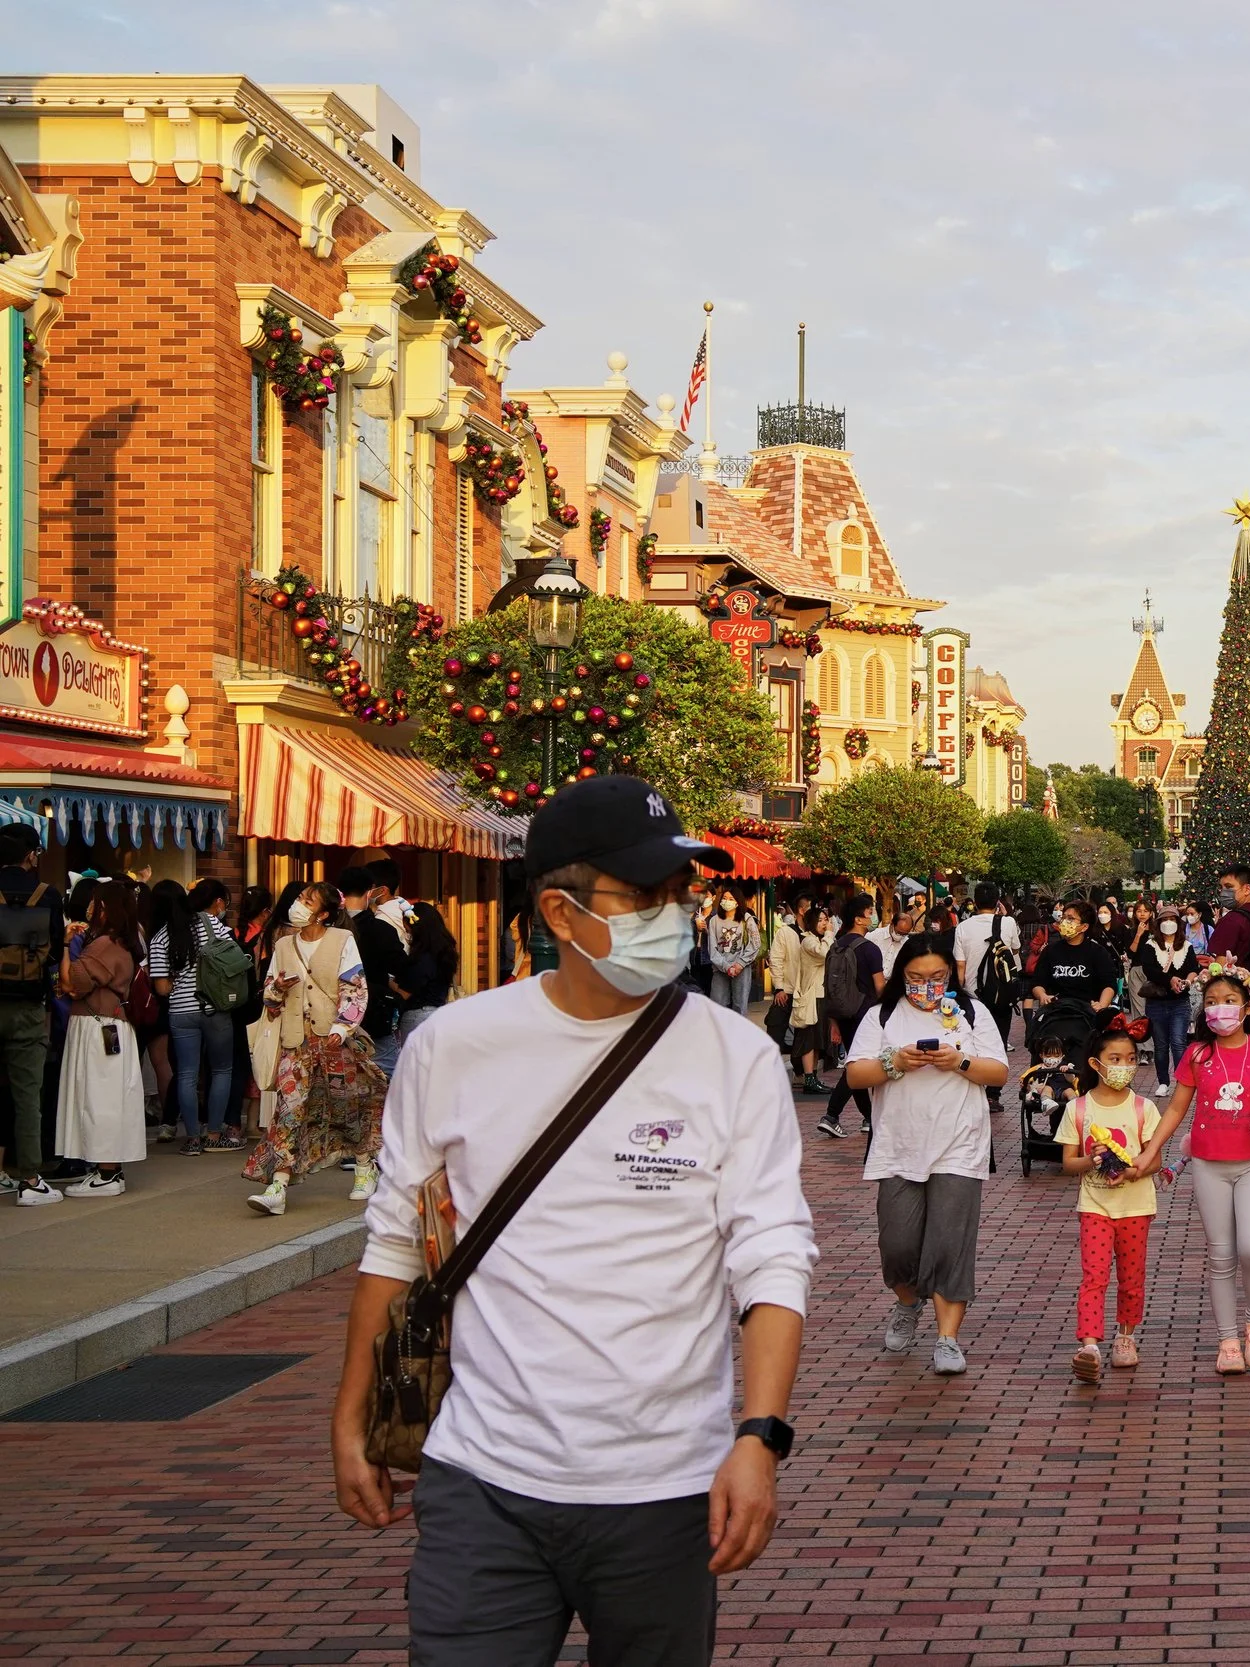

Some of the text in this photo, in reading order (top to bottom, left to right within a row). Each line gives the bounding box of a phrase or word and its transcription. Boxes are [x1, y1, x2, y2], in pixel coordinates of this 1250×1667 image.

[718, 623, 767, 639] Fine
[937, 644, 956, 776] COFFEE
[1011, 744, 1023, 808] GOO
[614, 1153, 697, 1168] SAN FRANCISCO
[629, 1165, 678, 1174] CALIFORNIA
